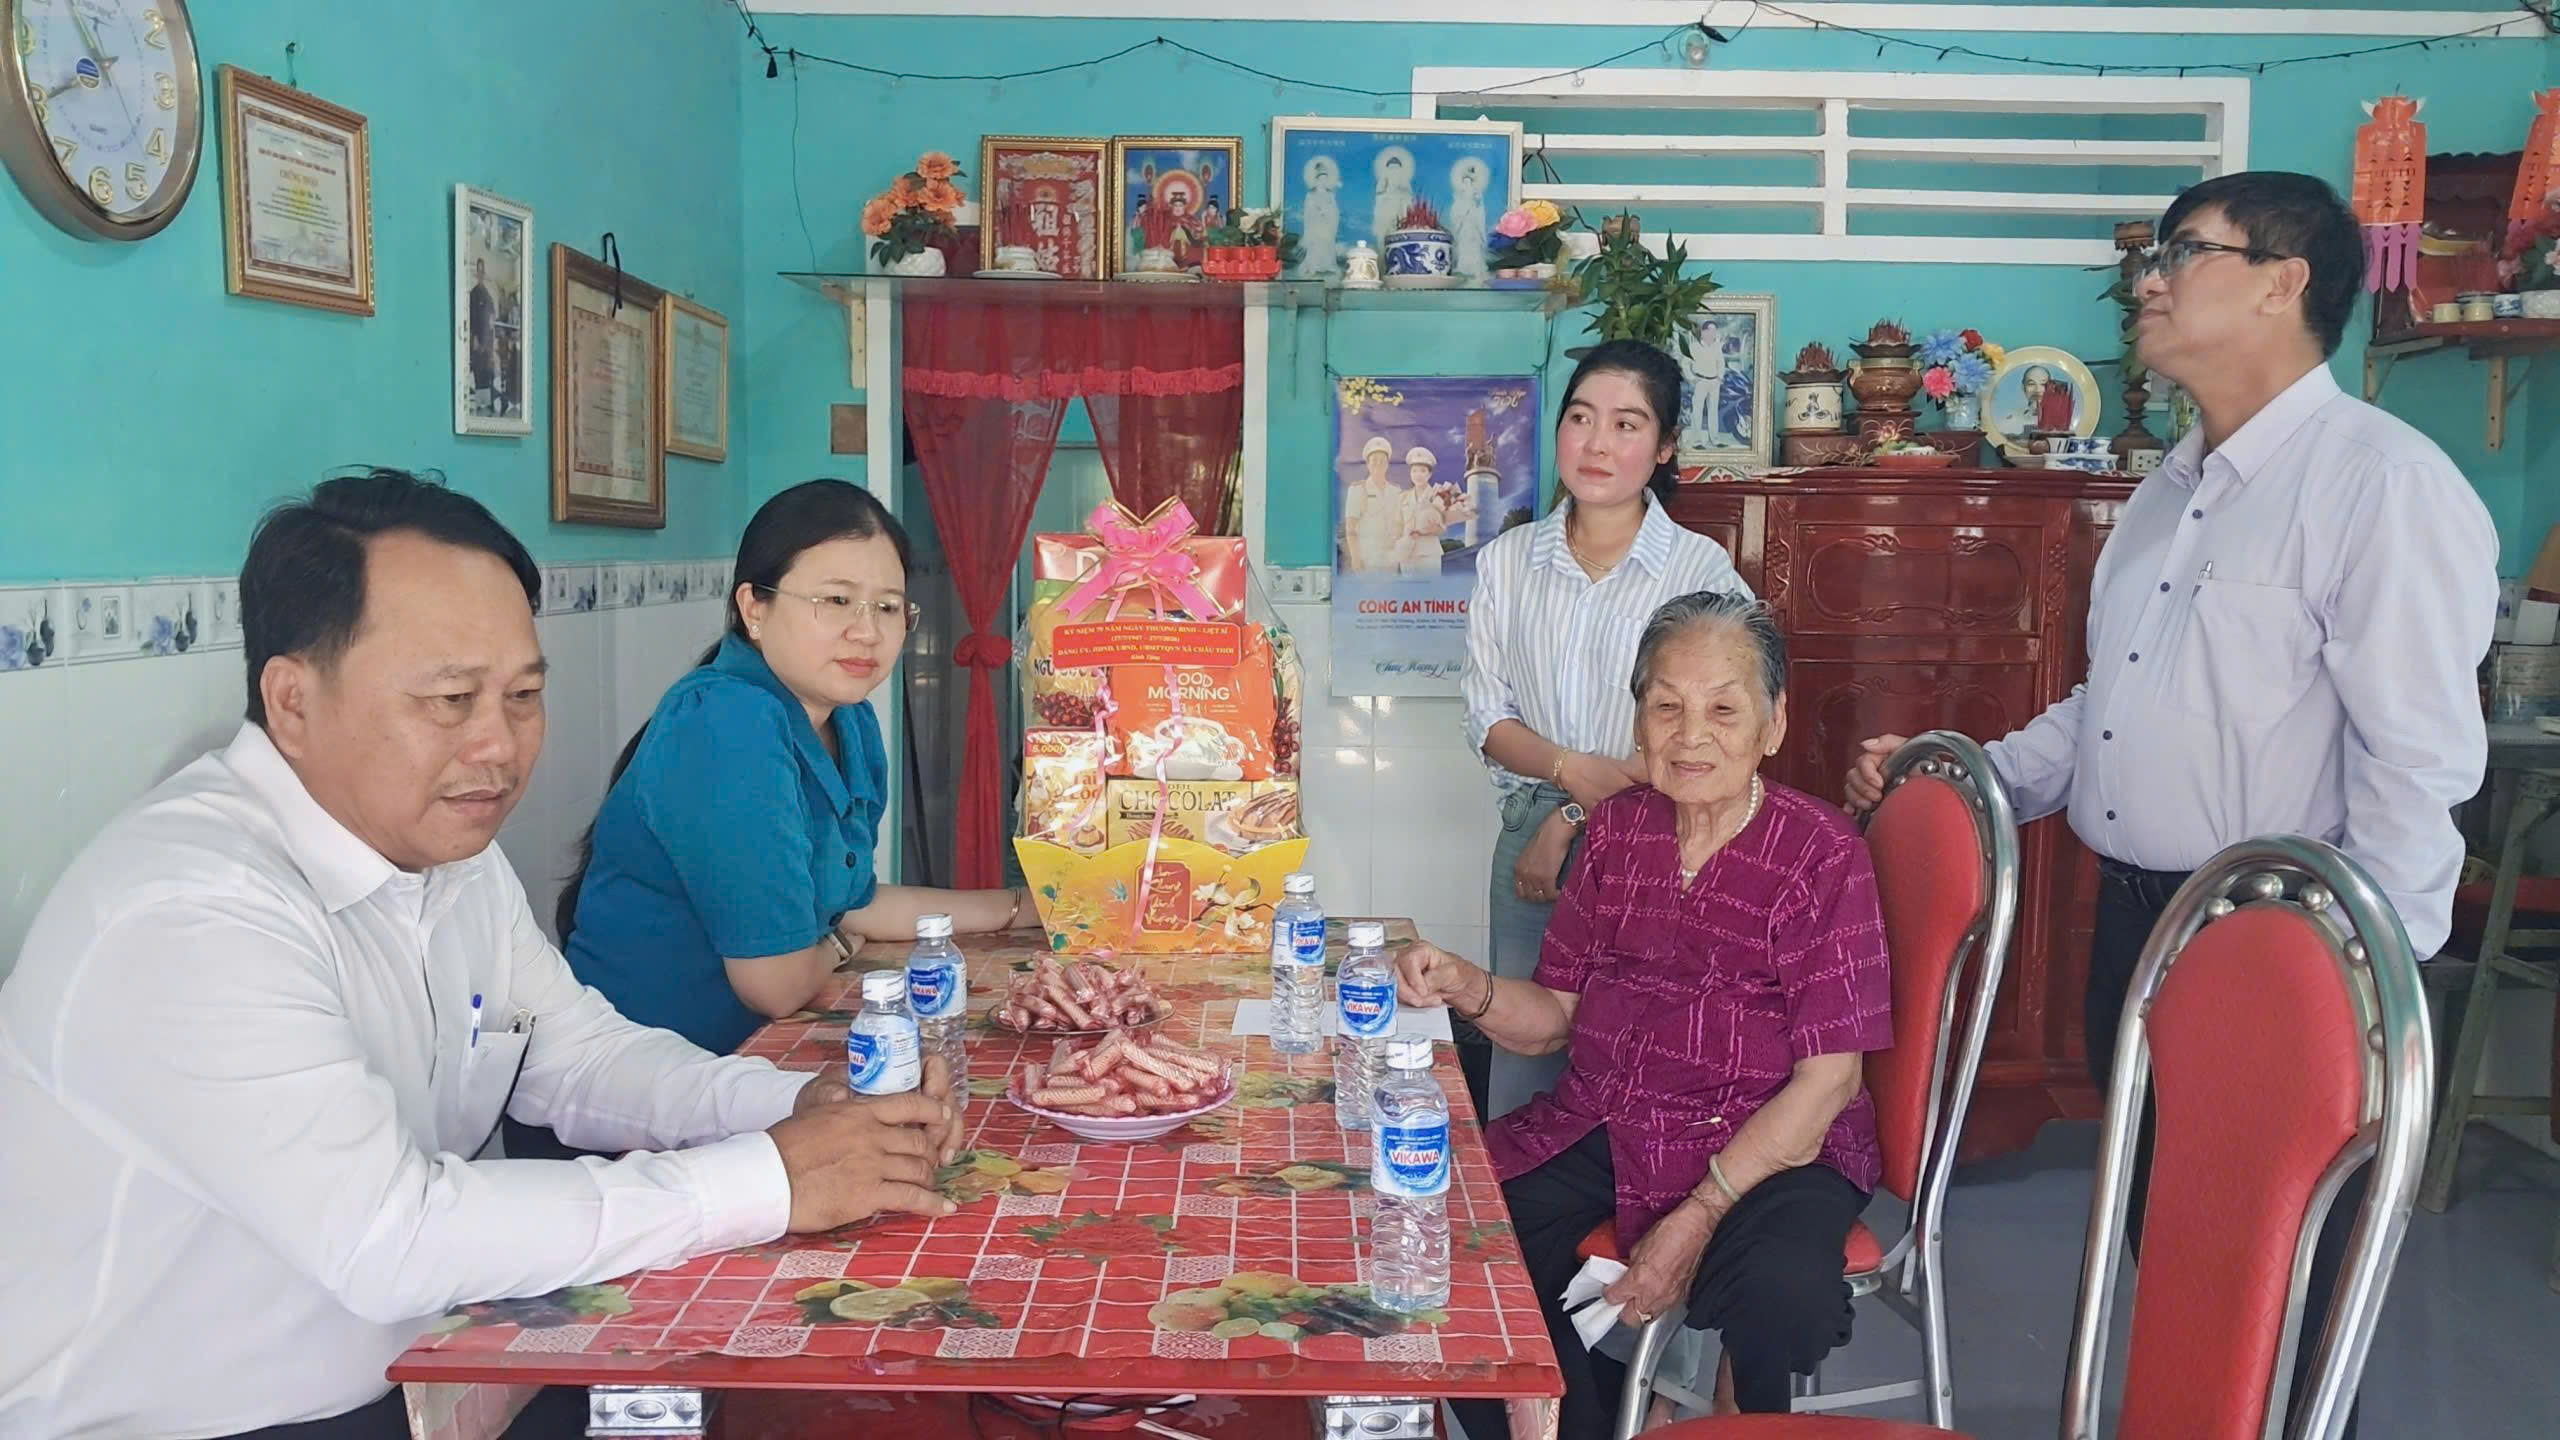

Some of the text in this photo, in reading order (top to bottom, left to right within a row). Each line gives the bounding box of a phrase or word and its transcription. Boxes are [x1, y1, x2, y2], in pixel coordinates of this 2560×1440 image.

[154, 71, 176, 111] 3
[51, 135, 78, 168] 7
[146, 127, 167, 165] 4
[88, 165, 113, 204] 6
[125, 160, 150, 200] 5
[1401, 600, 1421, 614] AN
[1392, 1150, 1440, 1164] VIKAWA
